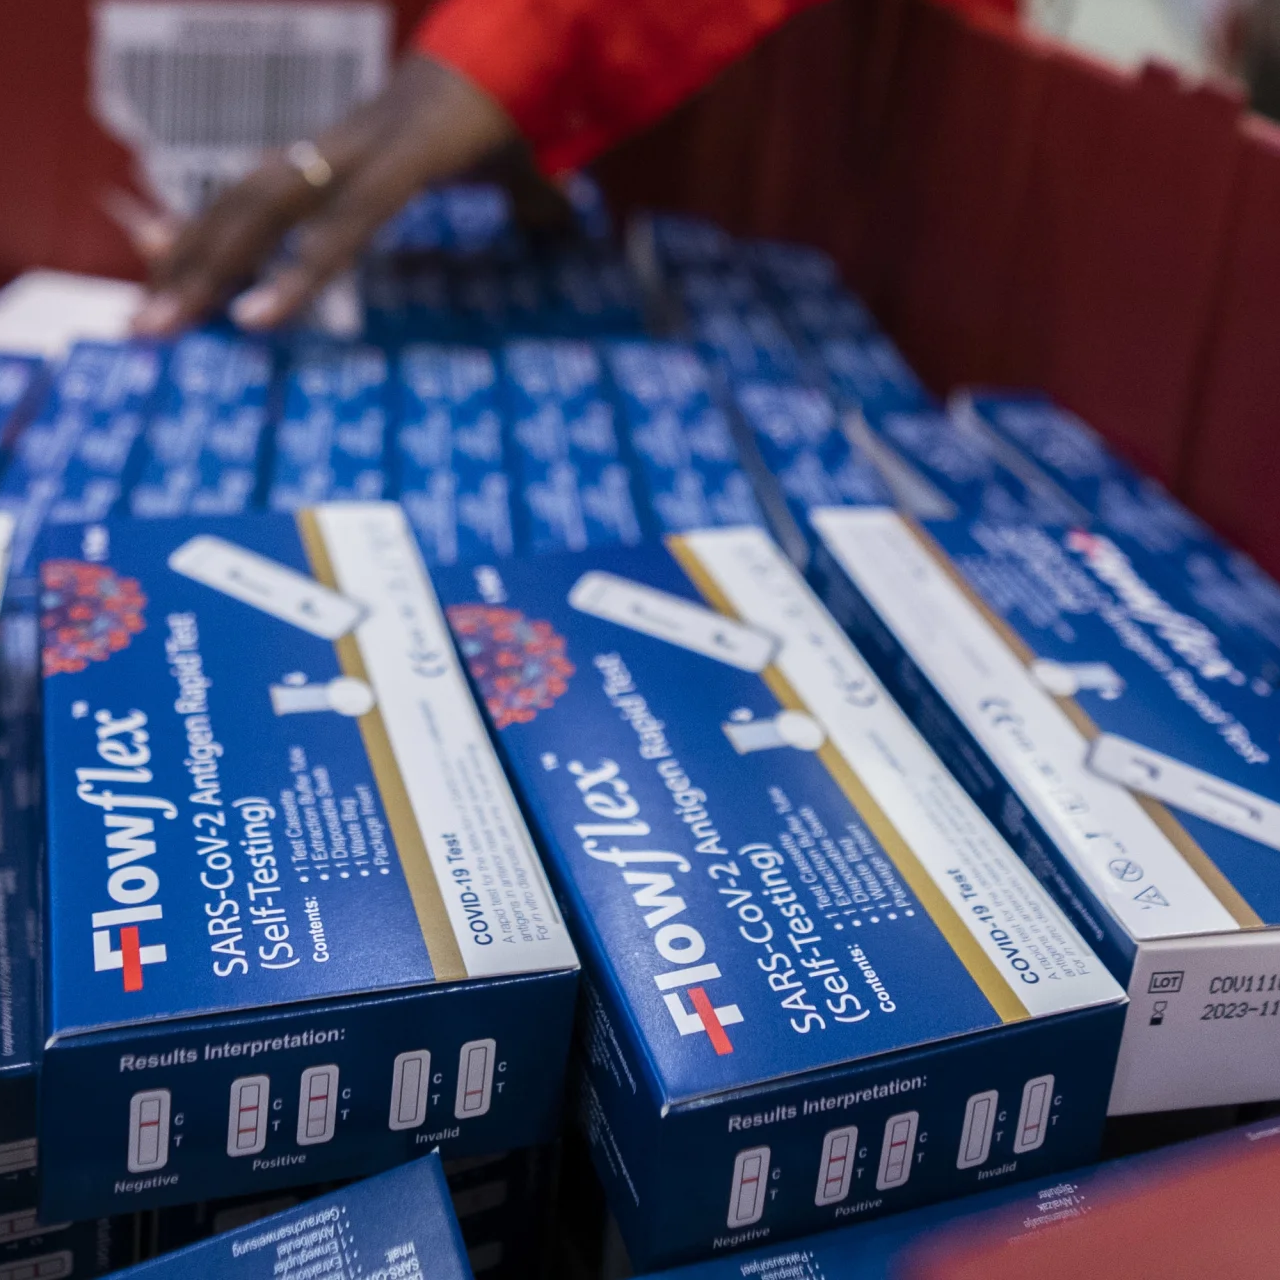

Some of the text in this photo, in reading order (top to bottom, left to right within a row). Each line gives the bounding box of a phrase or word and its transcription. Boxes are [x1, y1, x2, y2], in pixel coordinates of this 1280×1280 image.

[611, 695, 672, 759] Rapid
[165, 613, 249, 977] SARS-CoV-2 Antigen Rapid Test
[280, 790, 303, 838] Cassette
[341, 797, 358, 821] Bag
[657, 760, 728, 855] Antigen
[304, 807, 328, 861] Extraction
[322, 798, 348, 859] Disposable
[356, 786, 390, 866] Package Insert
[77, 708, 178, 992] Flowflex
[290, 840, 307, 863] Test
[348, 823, 367, 857] Waste
[779, 833, 817, 883] Cassette
[232, 797, 300, 969] (Self-Testing)
[808, 849, 852, 907] Extraction
[821, 839, 870, 903] Disposable
[857, 864, 886, 900] Waste
[870, 856, 911, 907] Package
[442, 833, 493, 945] COVID-19 Test
[486, 889, 503, 906] test
[809, 885, 832, 910] Test
[524, 892, 539, 911] vitro
[566, 759, 744, 1056] Flowflex
[304, 897, 329, 962] Contents:
[493, 909, 512, 934] rapid
[510, 901, 534, 942] antigens
[536, 925, 551, 941] For
[739, 843, 870, 1023] (Self-Testing)
[947, 869, 1040, 984] COVID-19 Test
[502, 935, 516, 944] A
[708, 861, 826, 1033] SARS-CoV-2
[1011, 924, 1061, 980] A rapid test
[1038, 936, 1076, 977] antigens
[847, 944, 896, 1012] Contents:
[1072, 959, 1091, 975] For
[1153, 976, 1180, 989] LOT
[119, 1027, 346, 1073] Results Interpretation:
[498, 1060, 508, 1073] C
[433, 1073, 443, 1085] C
[496, 1081, 505, 1094] T
[273, 1099, 283, 1111] C
[342, 1087, 352, 1100] C
[432, 1094, 441, 1106] T
[728, 1073, 928, 1133] Results Interpretation:
[1053, 1095, 1062, 1107] C
[174, 1114, 185, 1126] C
[272, 1120, 281, 1133] T
[341, 1108, 350, 1121] T
[998, 1110, 1007, 1122] C
[1051, 1115, 1059, 1127] T
[174, 1135, 184, 1148] T
[415, 1127, 460, 1145] Invalid
[919, 1132, 928, 1144] C
[996, 1131, 1003, 1142] T
[252, 1152, 307, 1171] Positive
[859, 1147, 868, 1159] C
[917, 1152, 925, 1164] T
[772, 1168, 781, 1180] C
[856, 1168, 864, 1179] T
[977, 1161, 1017, 1181] Invalid
[114, 1173, 179, 1195] Negative
[771, 1187, 778, 1201] T
[835, 1196, 883, 1218] Positive
[232, 1206, 340, 1258] Gebrauchsanweisung
[276, 1224, 335, 1259] Abfallbeutel
[713, 1226, 771, 1250] Negative
[274, 1240, 338, 1275] Einwegtupfer
[384, 1241, 416, 1264] Inhalt:
[741, 1250, 809, 1276] Pakkausohjeet
